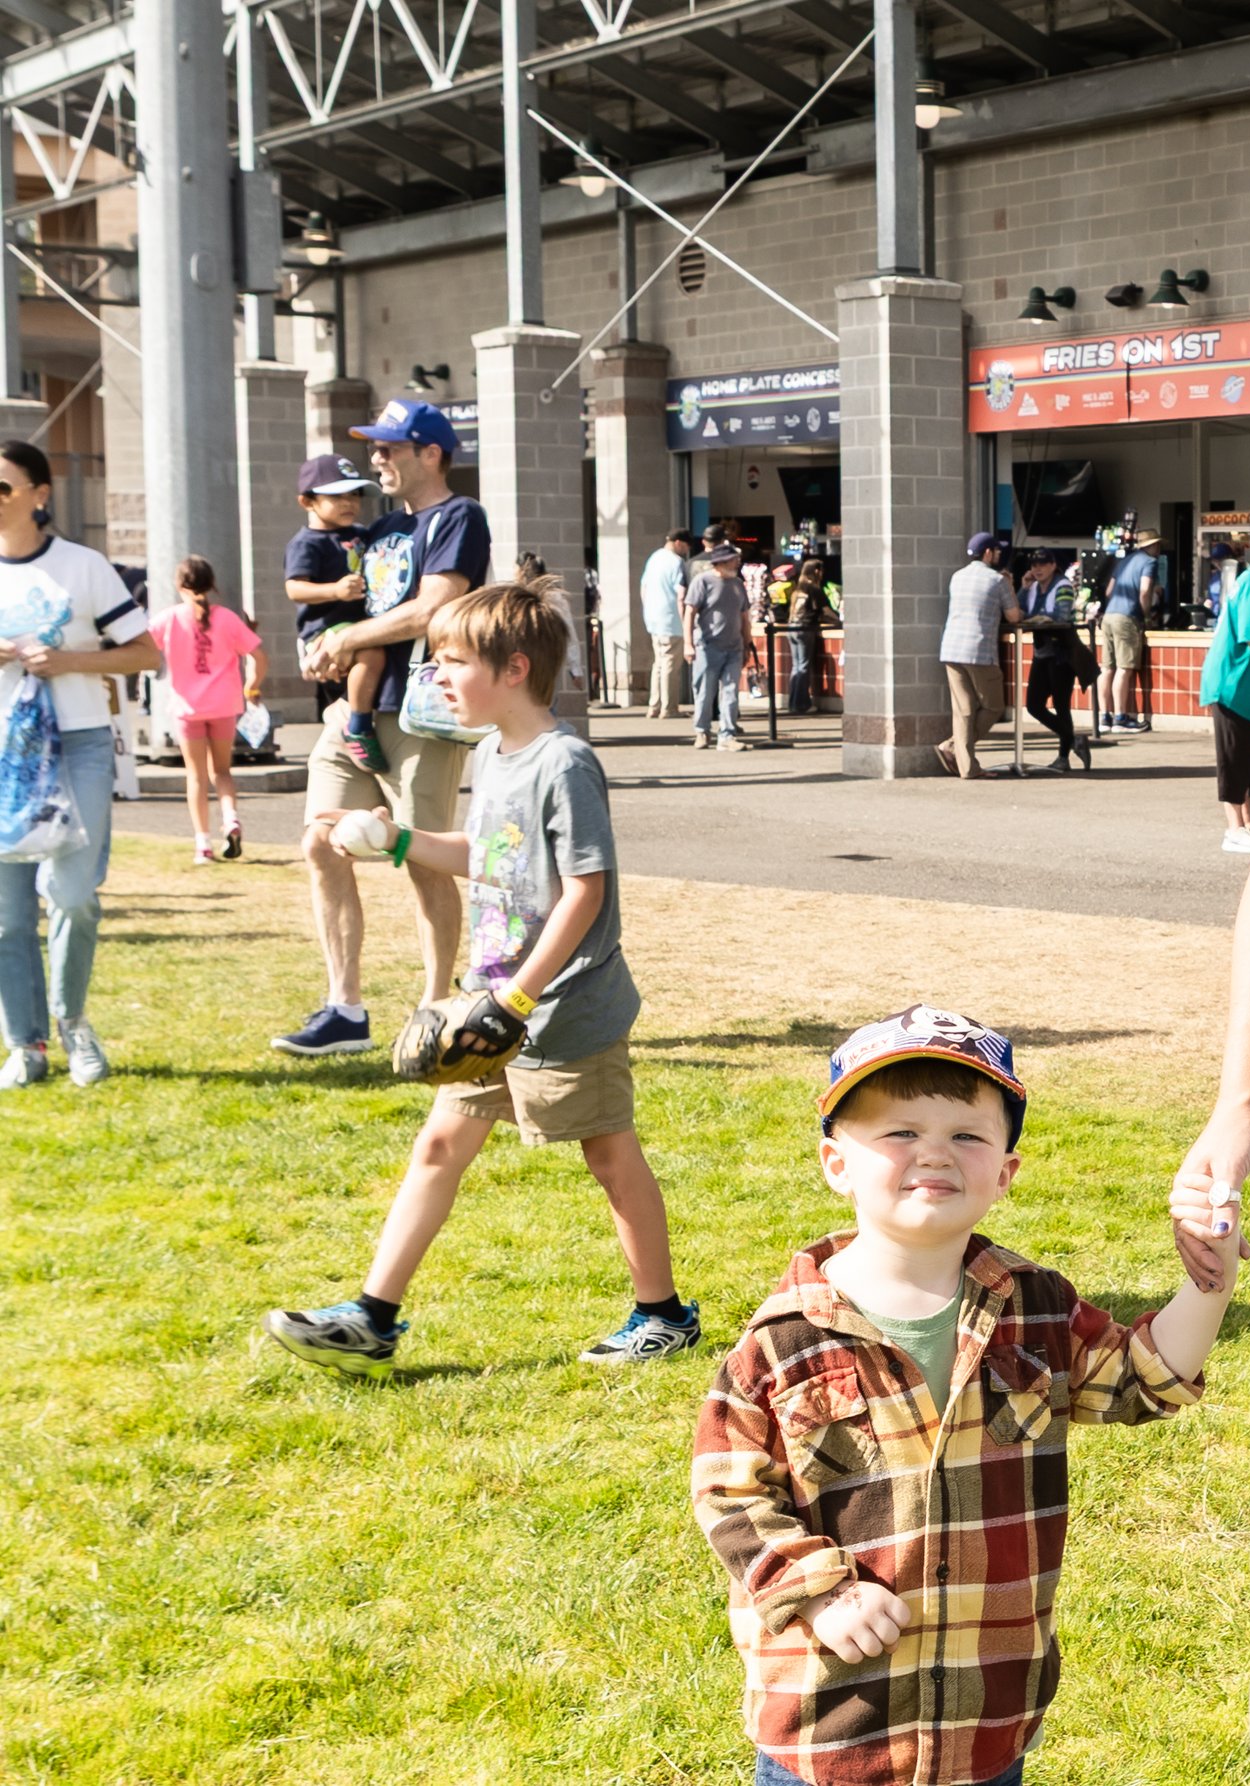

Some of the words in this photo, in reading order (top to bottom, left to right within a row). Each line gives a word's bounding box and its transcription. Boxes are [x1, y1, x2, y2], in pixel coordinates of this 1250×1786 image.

[1043, 340, 1116, 373] FRIES
[1122, 334, 1163, 366] ON
[1169, 330, 1221, 361] 1ST
[701, 379, 738, 396] HOME
[739, 374, 781, 392] PLATE
